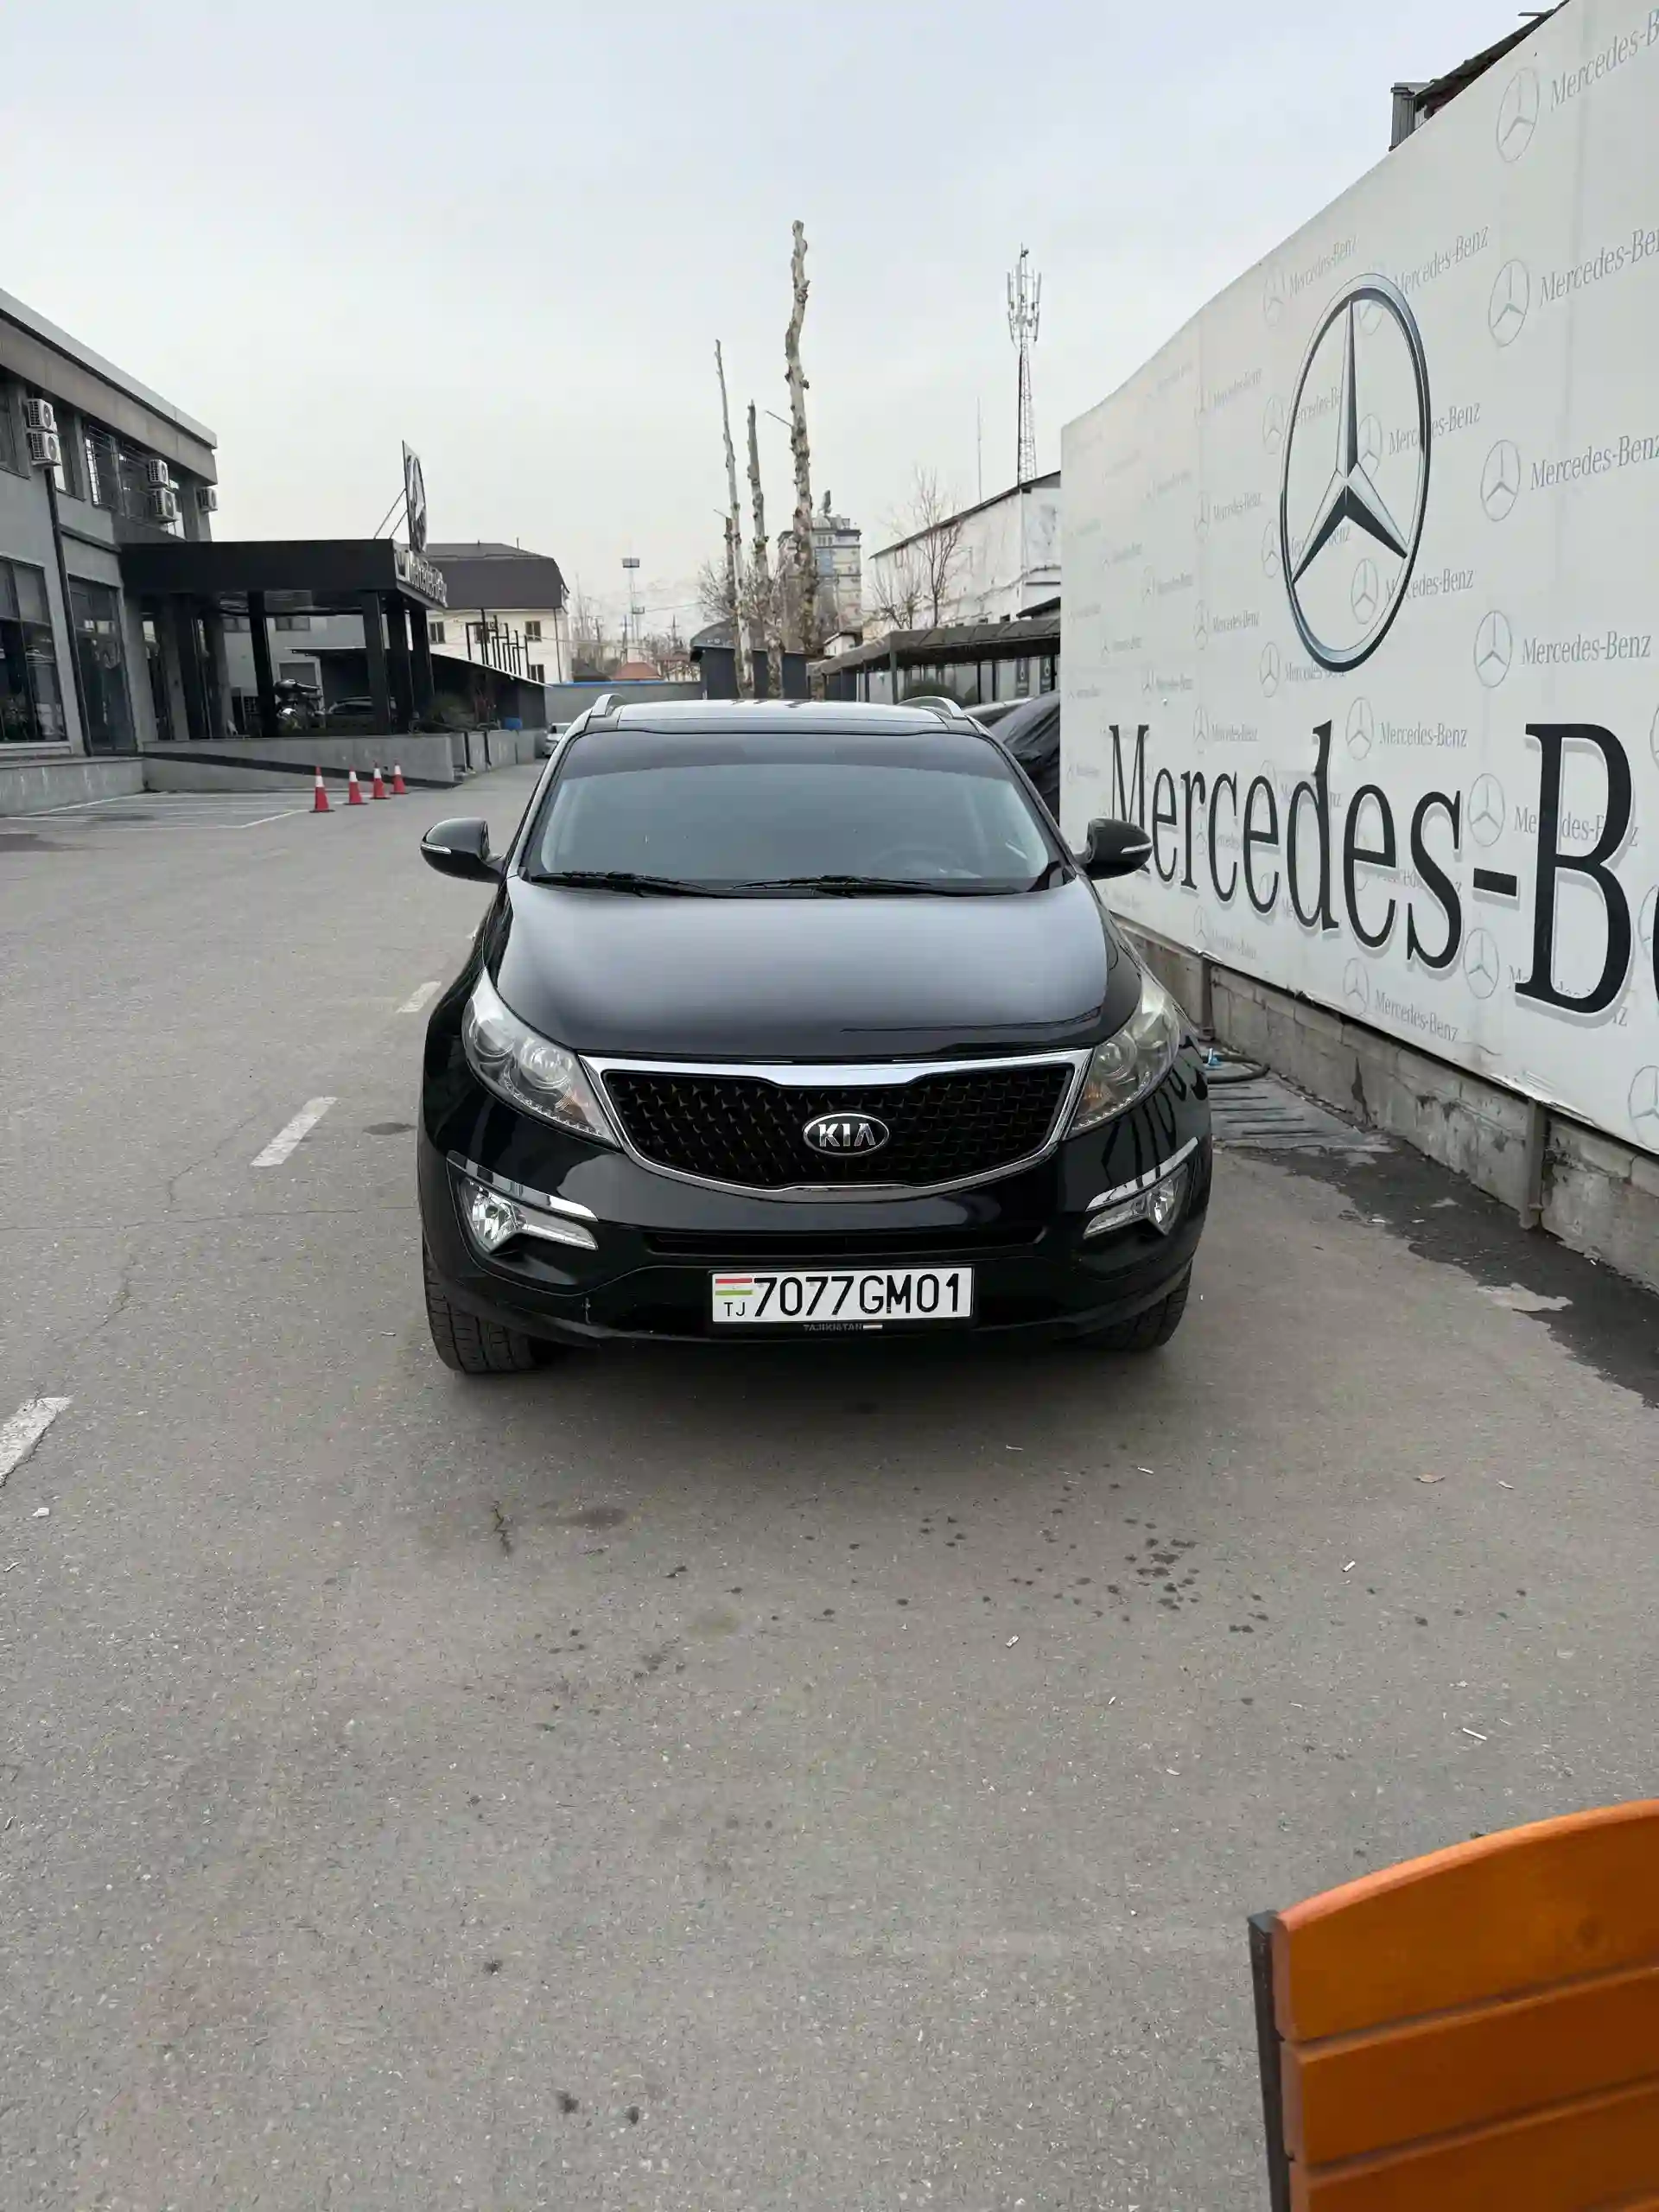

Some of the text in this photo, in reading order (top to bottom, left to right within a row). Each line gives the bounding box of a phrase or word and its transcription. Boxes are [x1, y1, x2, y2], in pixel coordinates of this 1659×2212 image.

[1389, 403, 1481, 456] Merces-Benz
[1520, 630, 1651, 665] Mercedes-Benz
[1379, 722, 1467, 747] Mercedes-Benz
[1109, 719, 1659, 1014] Mercedes-B
[817, 1122, 876, 1147] KIA
[723, 1273, 960, 1318] TJ 7077GM01
